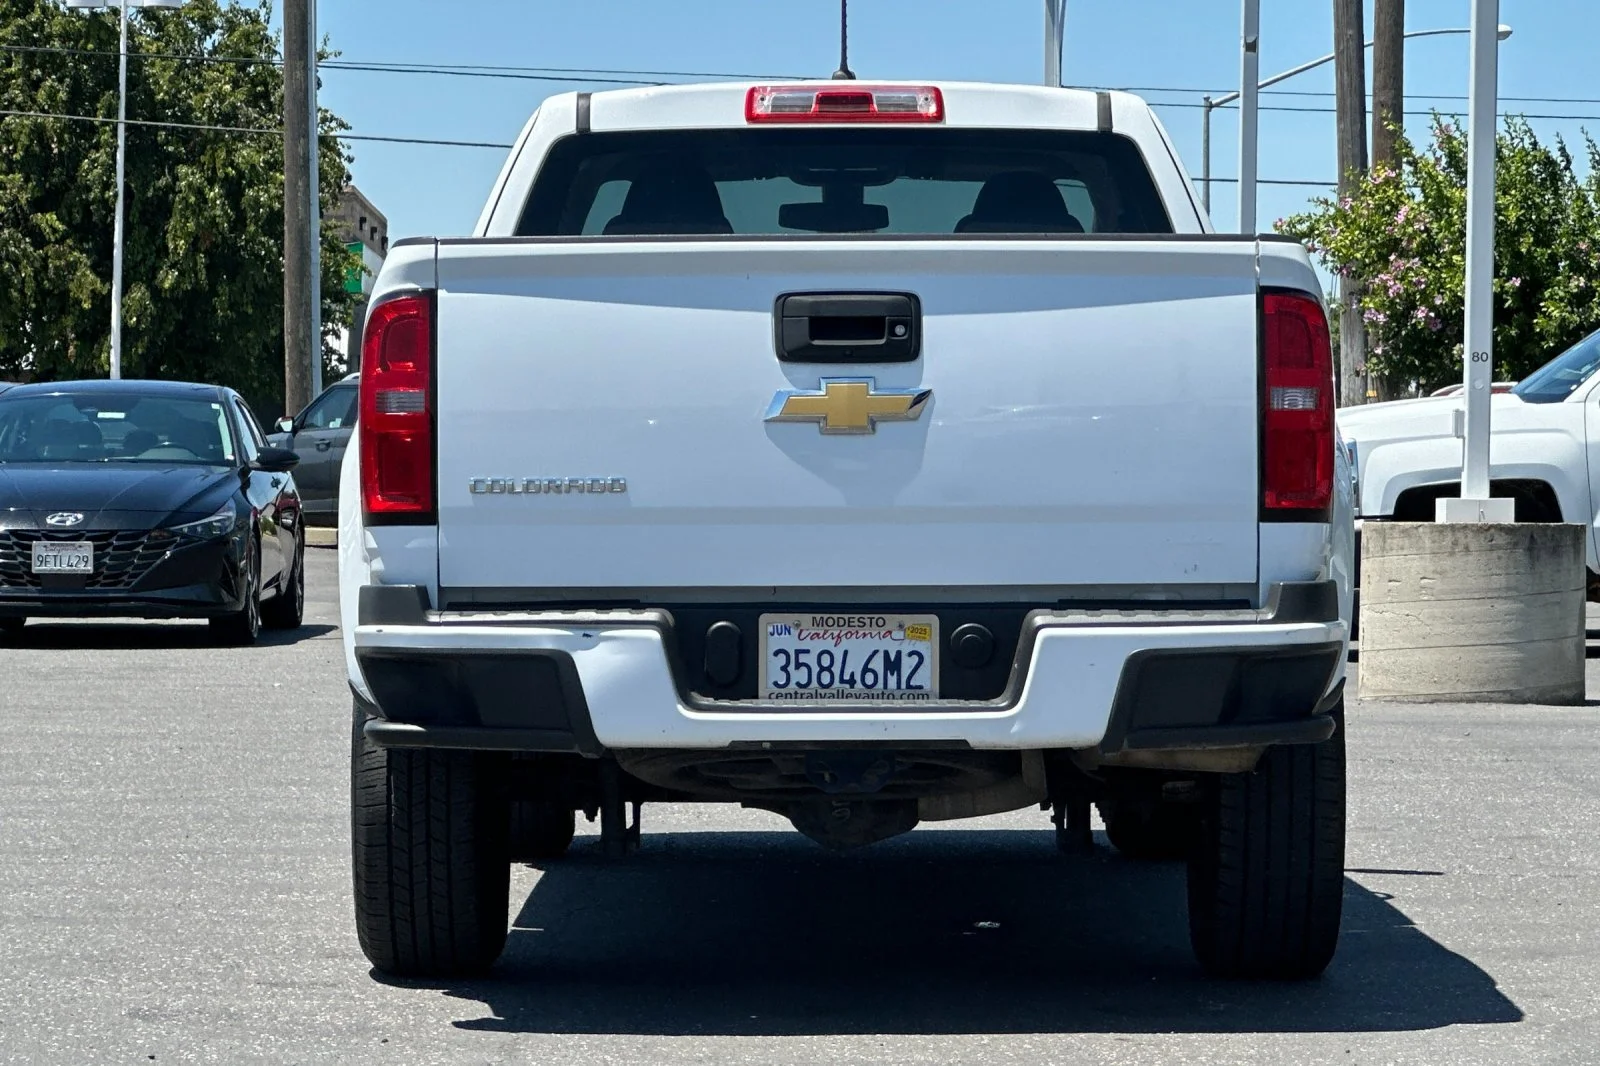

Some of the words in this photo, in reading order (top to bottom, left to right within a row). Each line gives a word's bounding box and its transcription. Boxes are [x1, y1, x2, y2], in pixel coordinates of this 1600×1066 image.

[1471, 351, 1489, 363] 80
[469, 476, 628, 495] COLORADO
[811, 616, 886, 628] MODESTO
[769, 624, 792, 637] JUN
[909, 627, 927, 635] 2025
[797, 628, 894, 647] California
[772, 648, 925, 690] 35846M2
